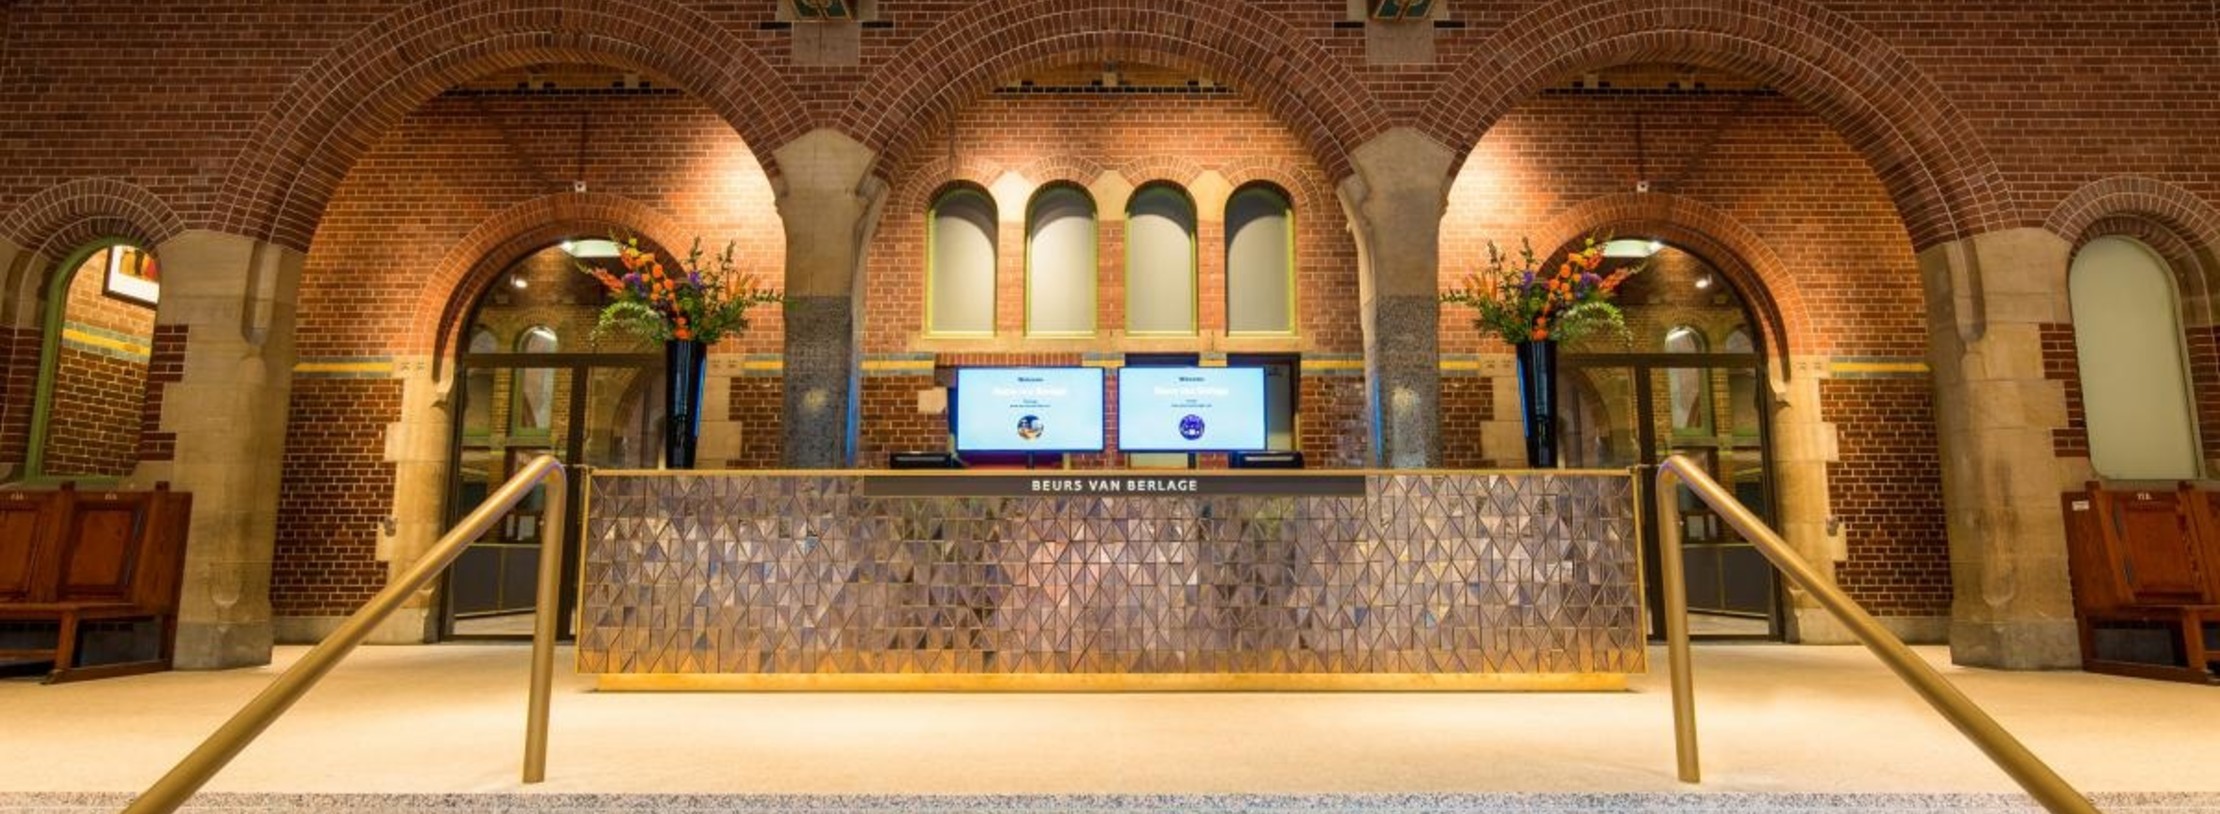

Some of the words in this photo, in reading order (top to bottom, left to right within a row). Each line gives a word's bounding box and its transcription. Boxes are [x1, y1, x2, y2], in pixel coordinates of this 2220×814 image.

[1031, 480, 1083, 492] BEURS
[1089, 480, 1121, 492] VAN
[1127, 480, 1197, 492] BERLAGE
